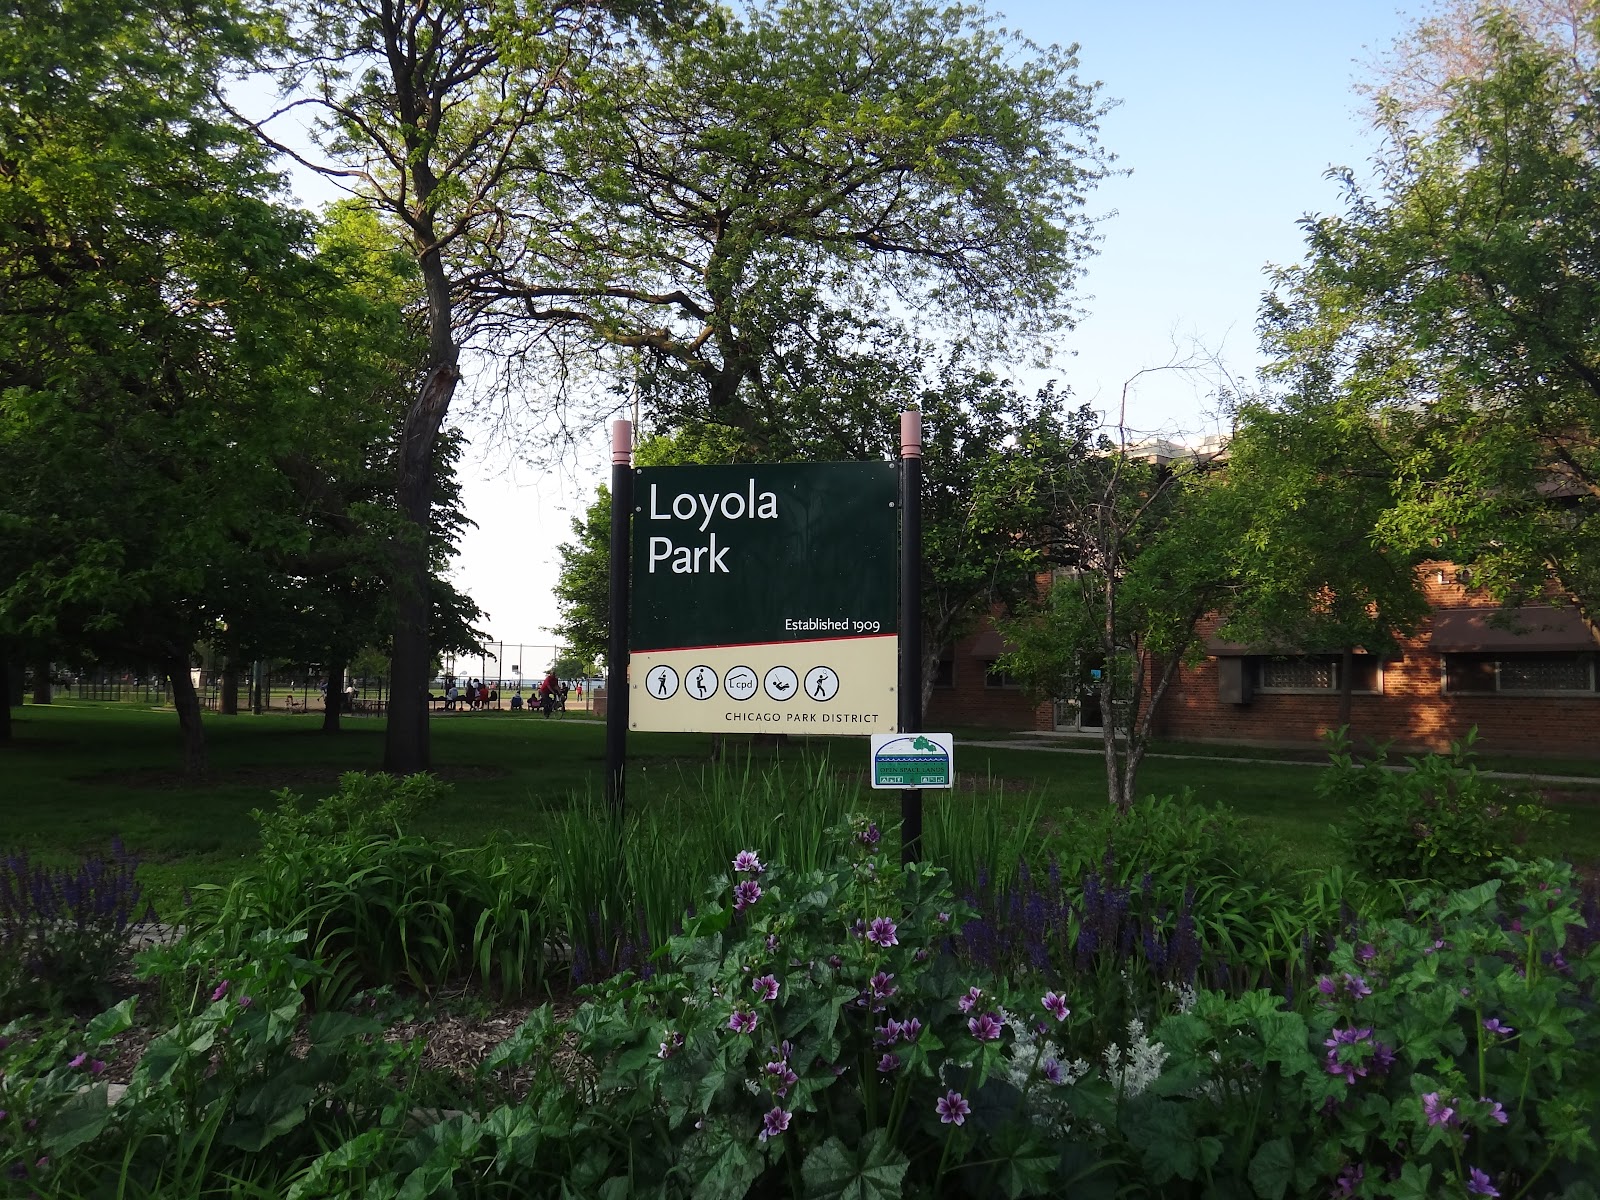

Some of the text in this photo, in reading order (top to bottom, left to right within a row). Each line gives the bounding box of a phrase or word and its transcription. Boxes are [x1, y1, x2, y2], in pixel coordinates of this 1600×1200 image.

[650, 478, 779, 532] Loyola
[648, 533, 730, 574] Park
[785, 618, 881, 633] Established 1909
[736, 678, 754, 690] cpd
[725, 712, 880, 723] CHICAGO PARK DISTRICT
